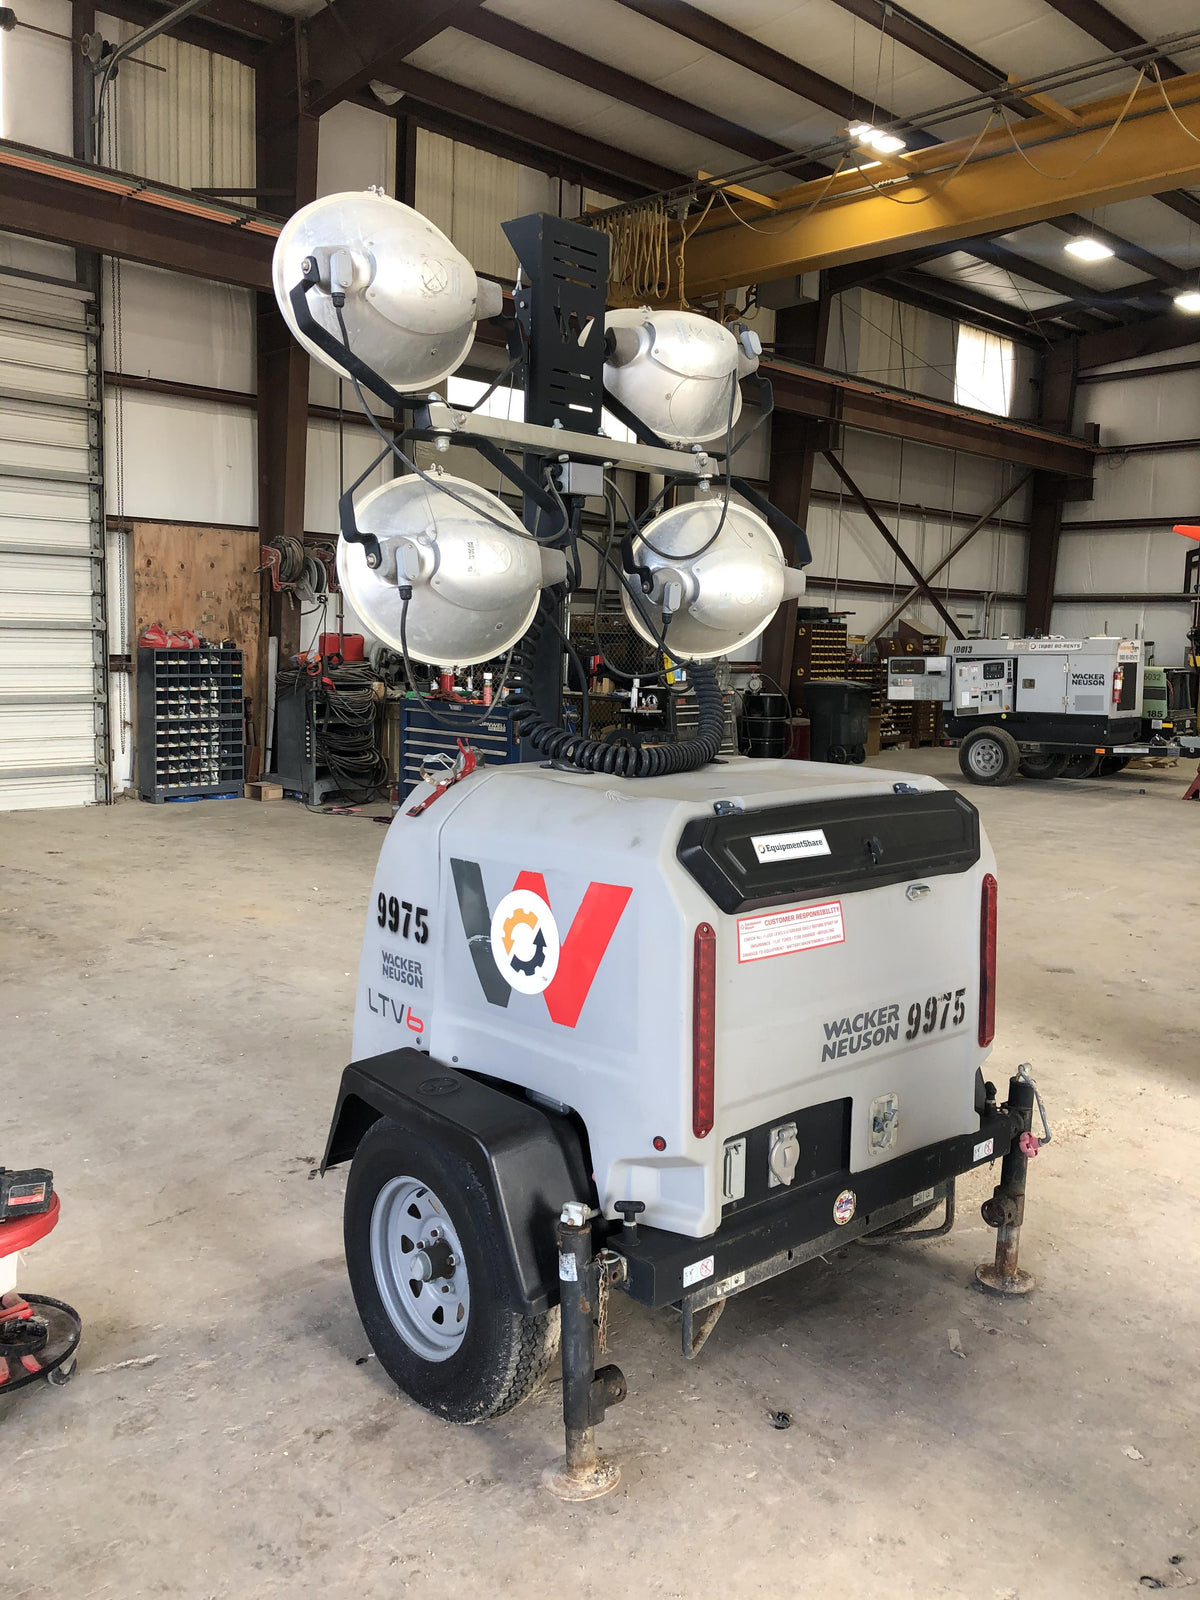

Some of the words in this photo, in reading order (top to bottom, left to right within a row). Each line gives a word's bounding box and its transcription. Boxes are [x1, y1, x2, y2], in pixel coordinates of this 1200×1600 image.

[1147, 710, 1163, 718] 185
[765, 839, 823, 853] EquipmentShare
[377, 891, 429, 944] 9975
[764, 915, 794, 926] CUSTOMER
[795, 906, 840, 920] RESPONSIBILITY
[382, 950, 423, 975] WACKER
[382, 964, 423, 989] NEUSON
[368, 987, 424, 1033] LTV6
[823, 1003, 900, 1041] WACKER
[905, 987, 966, 1041] 9975
[821, 1022, 900, 1063] NEUSON
